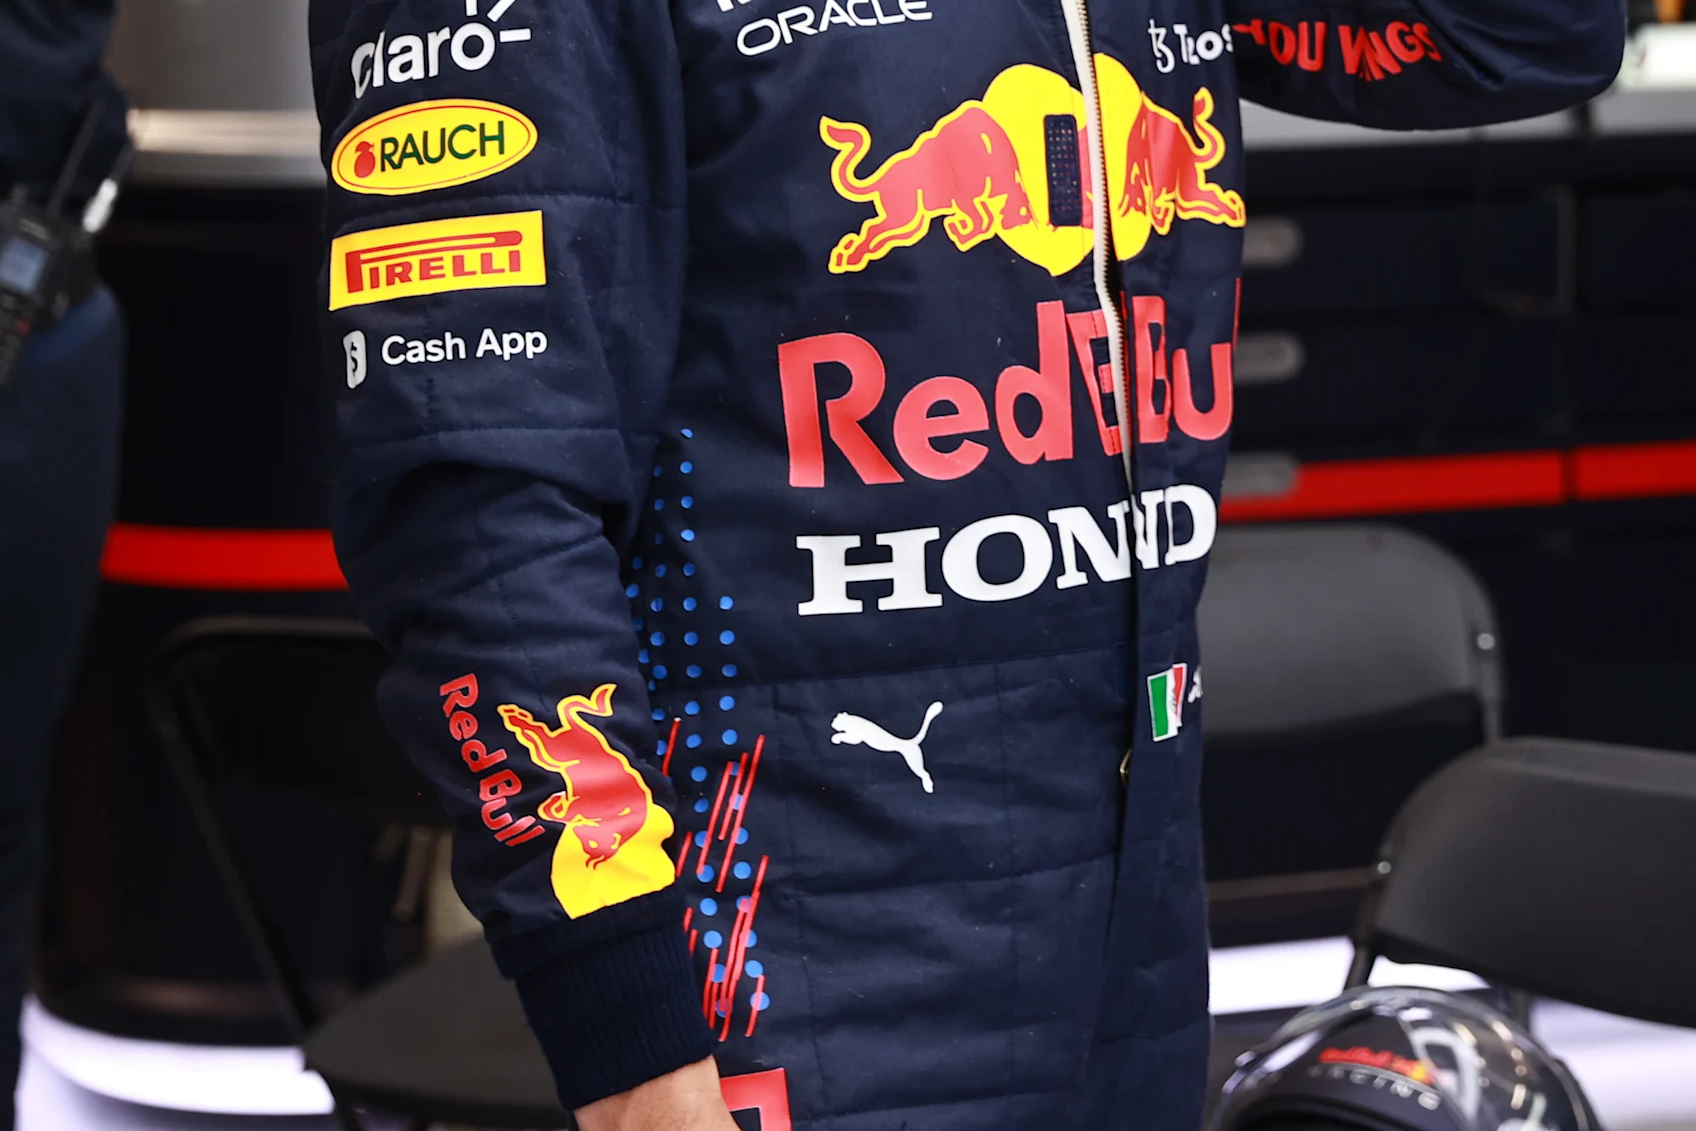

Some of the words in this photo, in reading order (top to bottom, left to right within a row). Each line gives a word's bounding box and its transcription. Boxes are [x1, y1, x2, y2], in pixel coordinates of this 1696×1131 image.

[380, 121, 505, 172] RAUCH
[346, 231, 523, 293] PIRELLI
[381, 332, 466, 365] Cash
[476, 328, 548, 364] App
[796, 484, 1218, 616] HOND
